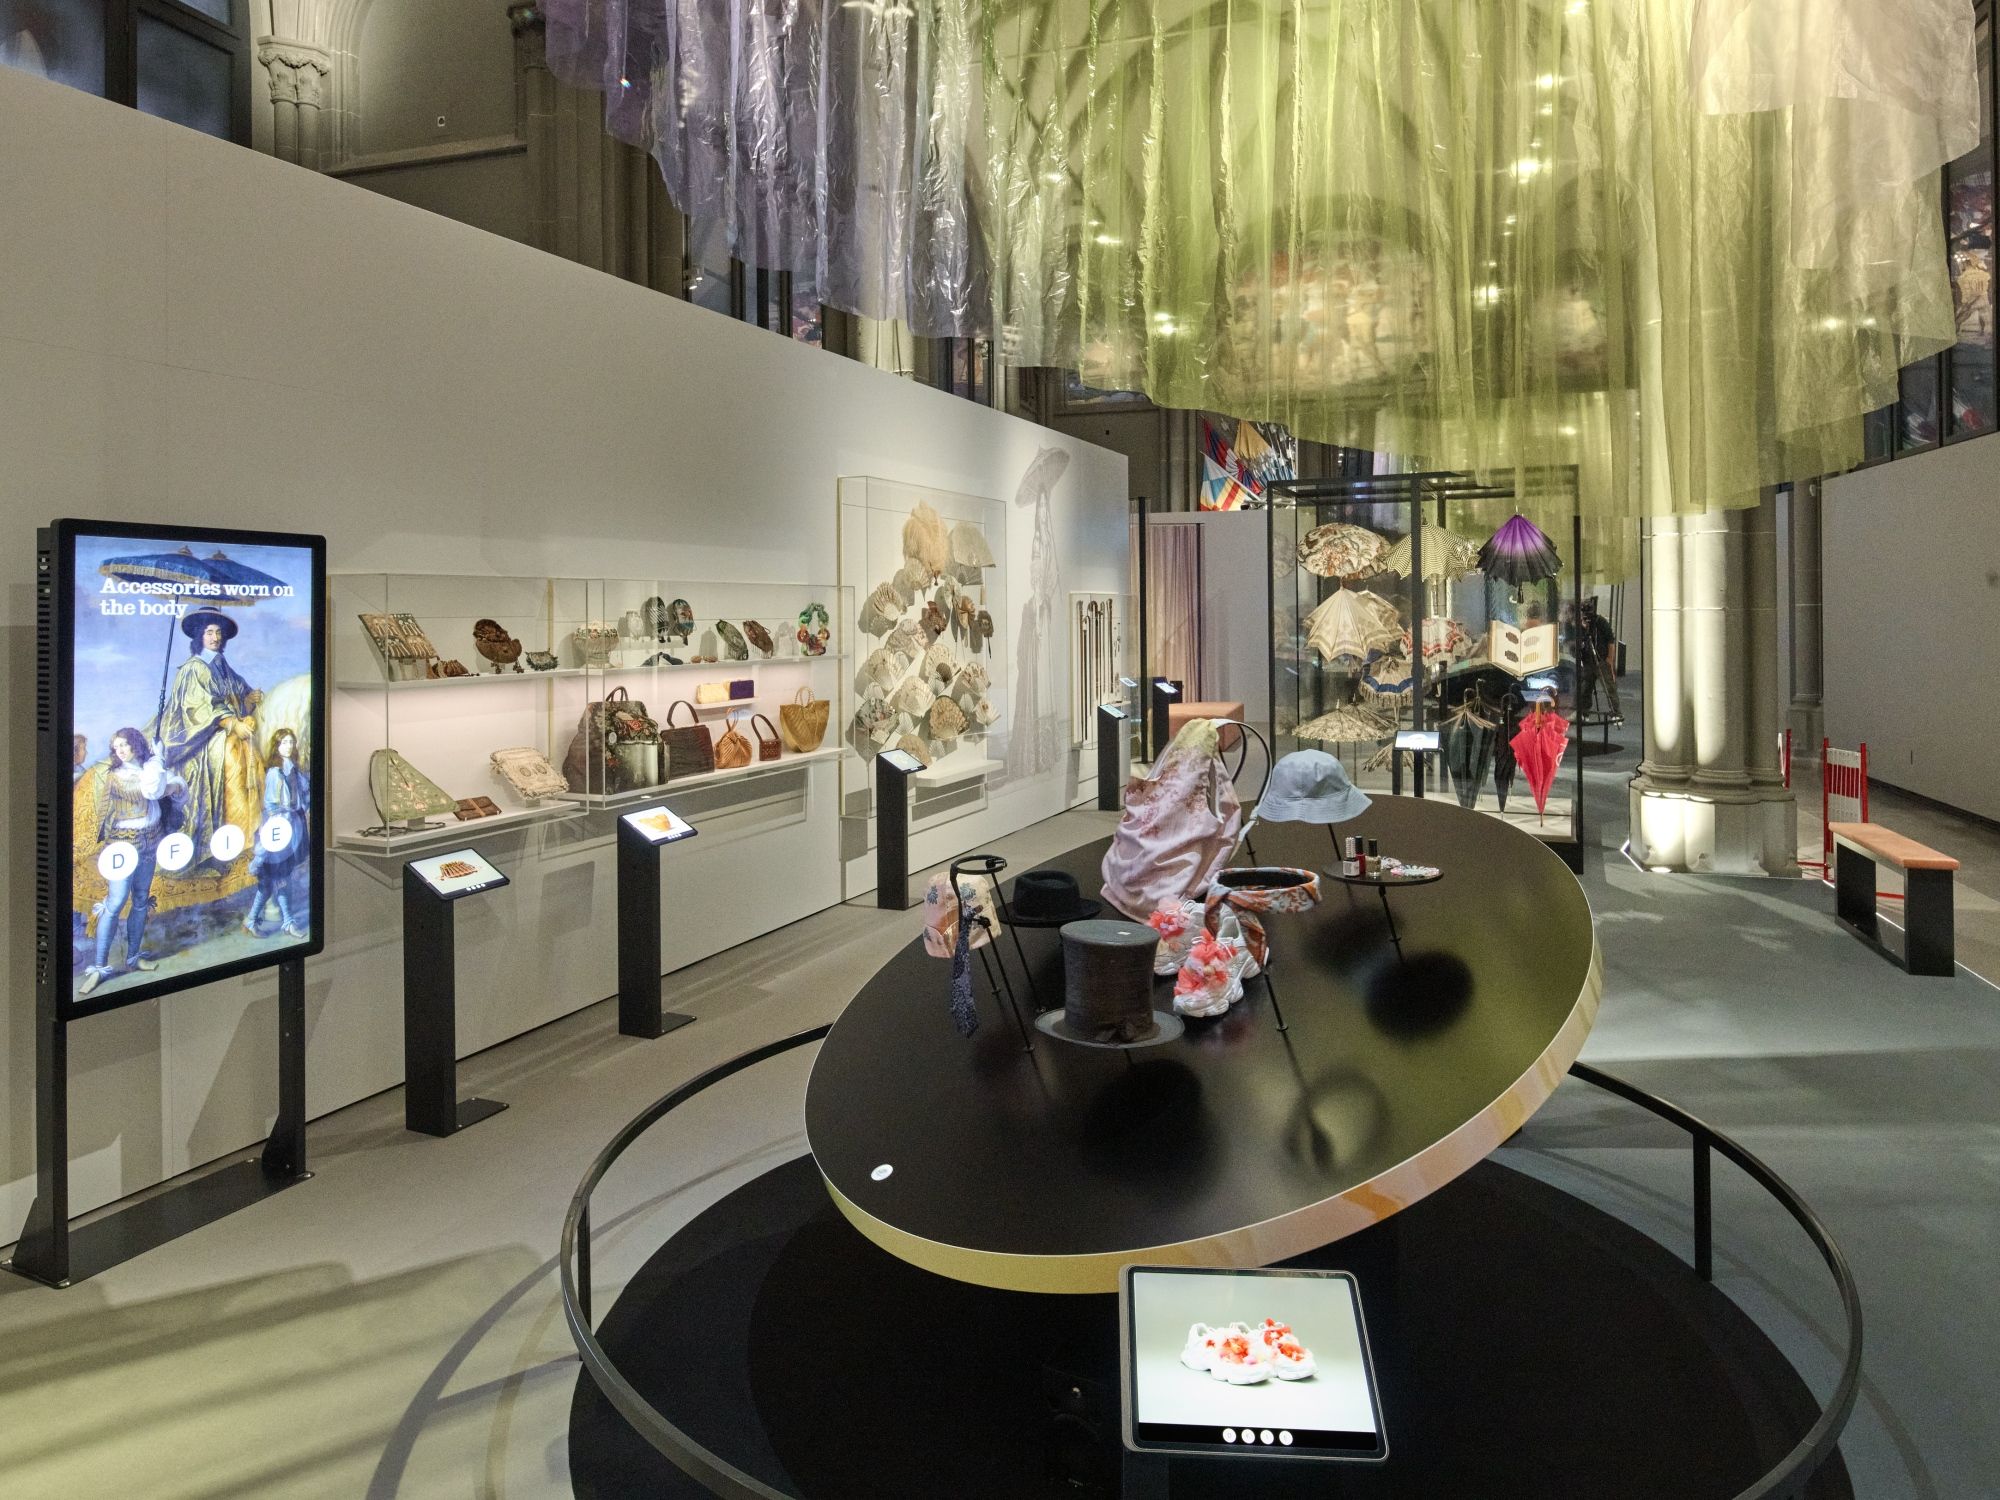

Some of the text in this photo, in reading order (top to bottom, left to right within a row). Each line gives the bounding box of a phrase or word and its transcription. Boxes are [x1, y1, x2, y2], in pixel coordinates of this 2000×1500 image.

[99, 577, 294, 597] Accessories worn on
[99, 599, 189, 619] the body
[112, 853, 125, 869] D
[170, 844, 181, 859] F
[271, 827, 281, 842] E
